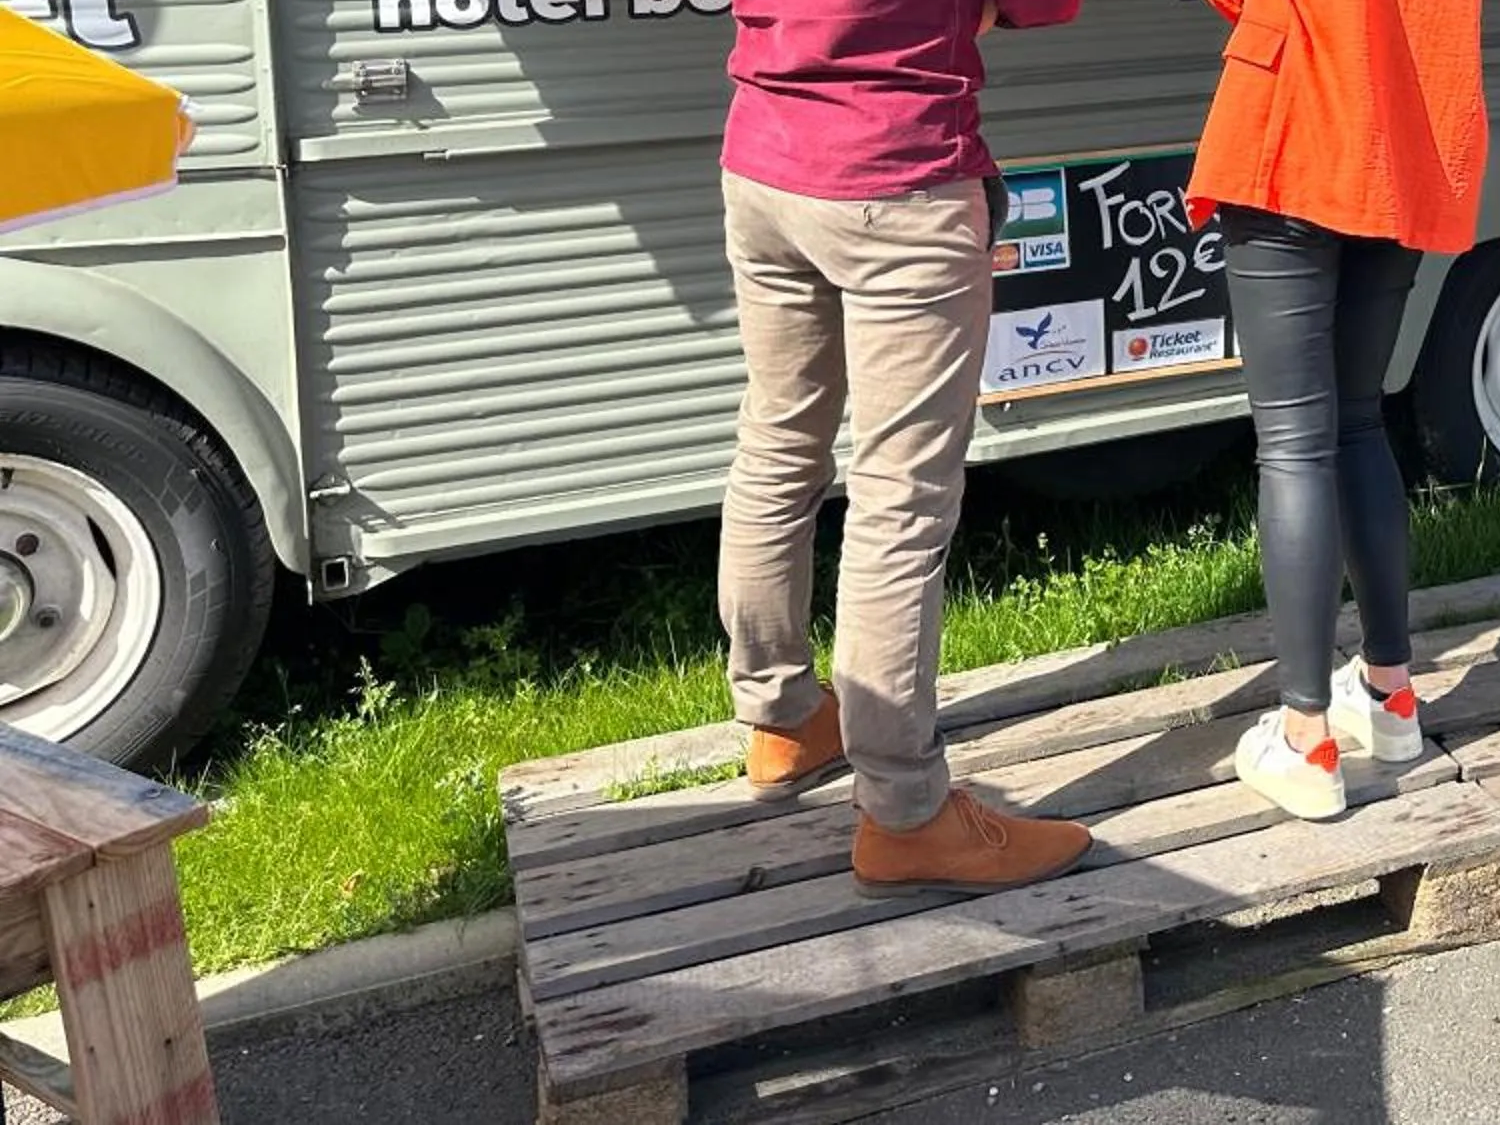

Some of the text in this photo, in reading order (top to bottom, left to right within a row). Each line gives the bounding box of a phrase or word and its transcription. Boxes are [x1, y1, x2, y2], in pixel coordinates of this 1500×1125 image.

[1029, 241, 1064, 256] VISA
[1150, 330, 1202, 347] Ticket
[998, 355, 1085, 381] ancv
